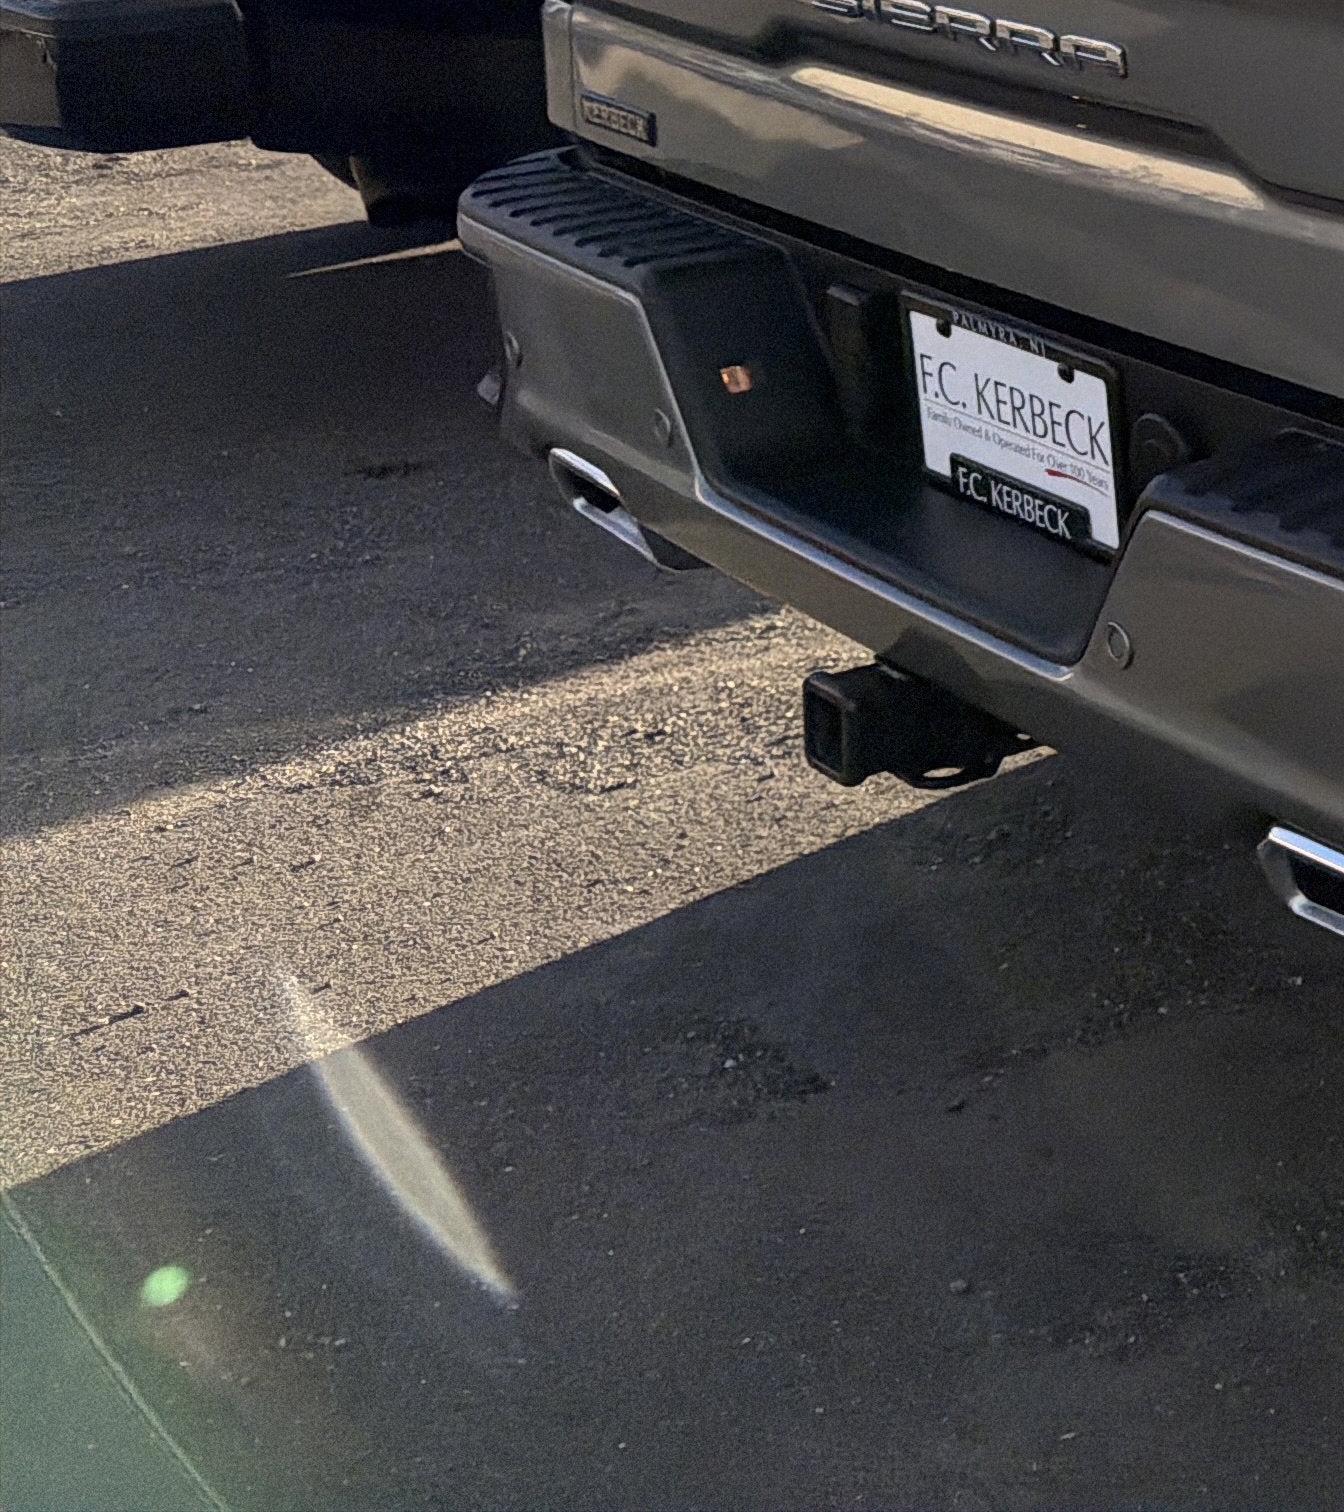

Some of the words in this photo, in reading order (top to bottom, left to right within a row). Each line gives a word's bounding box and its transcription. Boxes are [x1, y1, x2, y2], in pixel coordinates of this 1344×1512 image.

[919, 353, 967, 409] F.C.
[974, 373, 1109, 466] KERBECK
[957, 466, 987, 502] F.C.
[990, 480, 1072, 540] KERBECK
